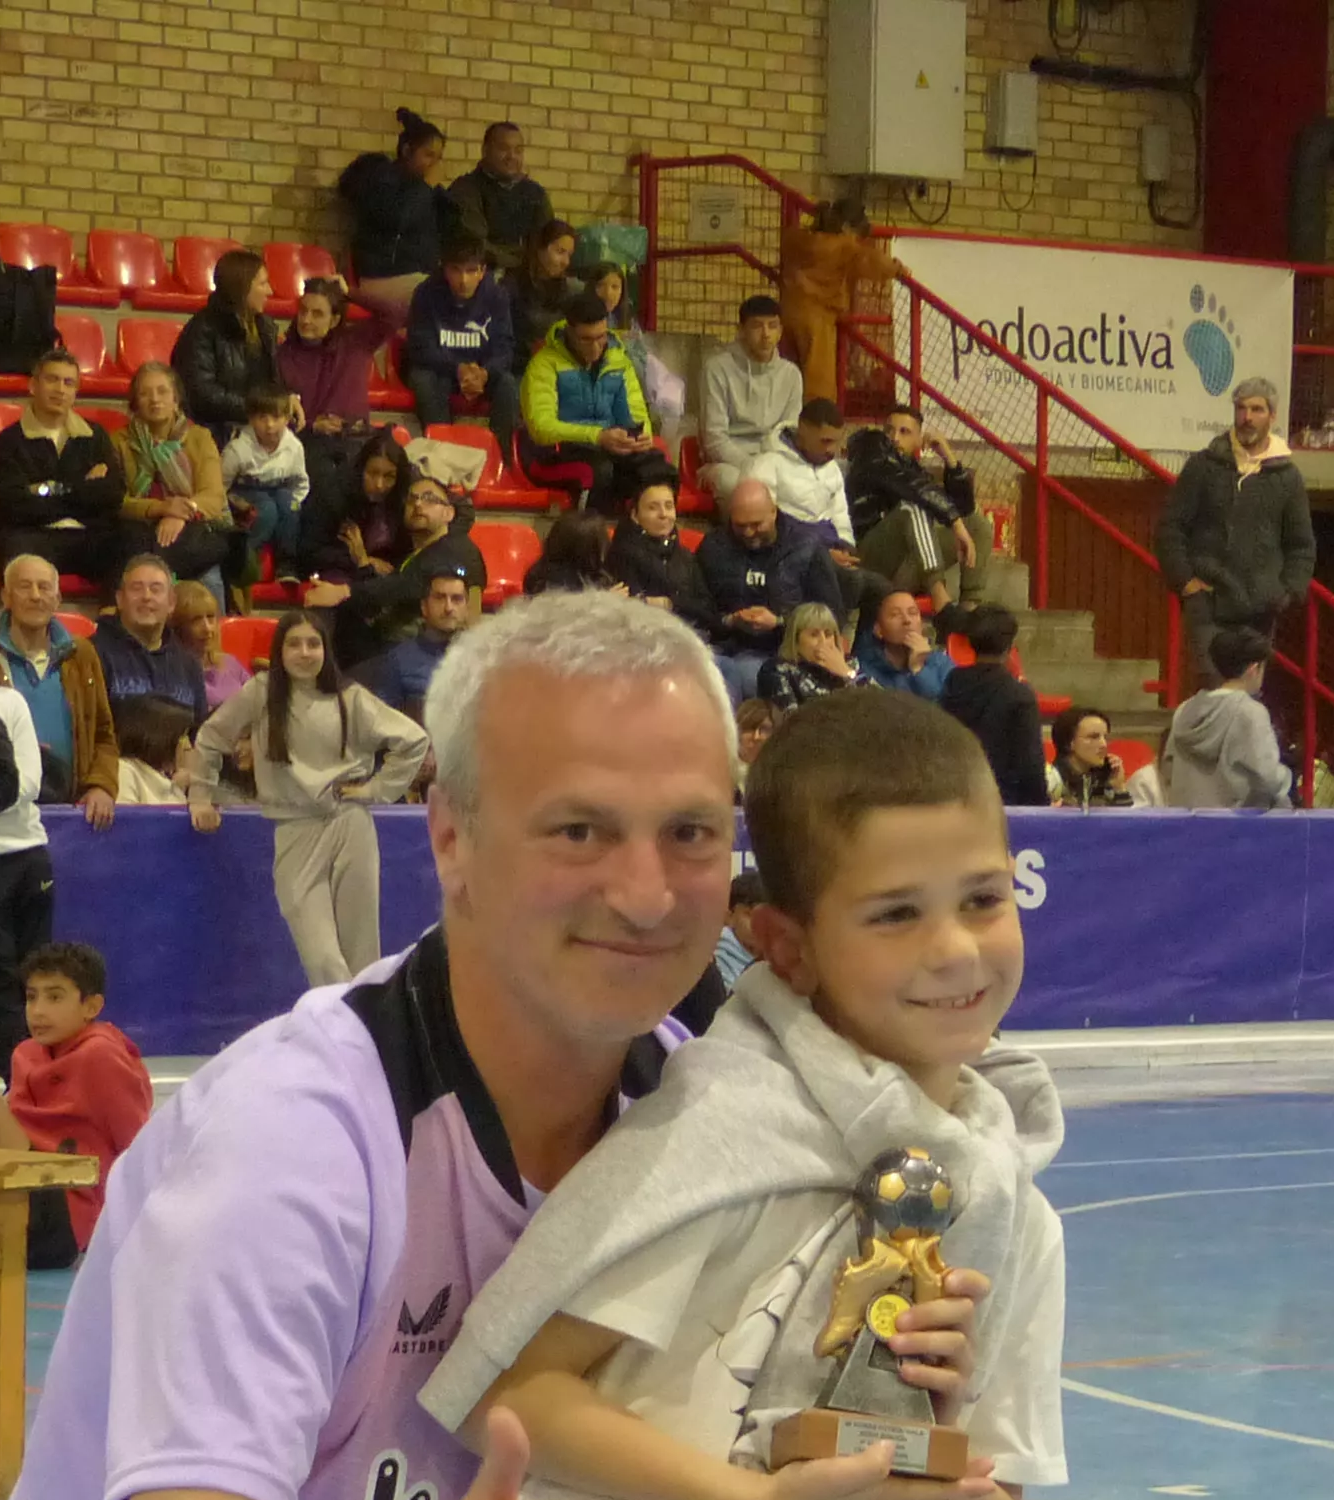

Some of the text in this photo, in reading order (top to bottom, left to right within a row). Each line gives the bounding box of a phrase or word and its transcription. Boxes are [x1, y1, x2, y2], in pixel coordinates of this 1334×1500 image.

[440, 329, 481, 348] PUMA
[1069, 374, 1076, 388] Y
[390, 1340, 449, 1354] ASTORE
